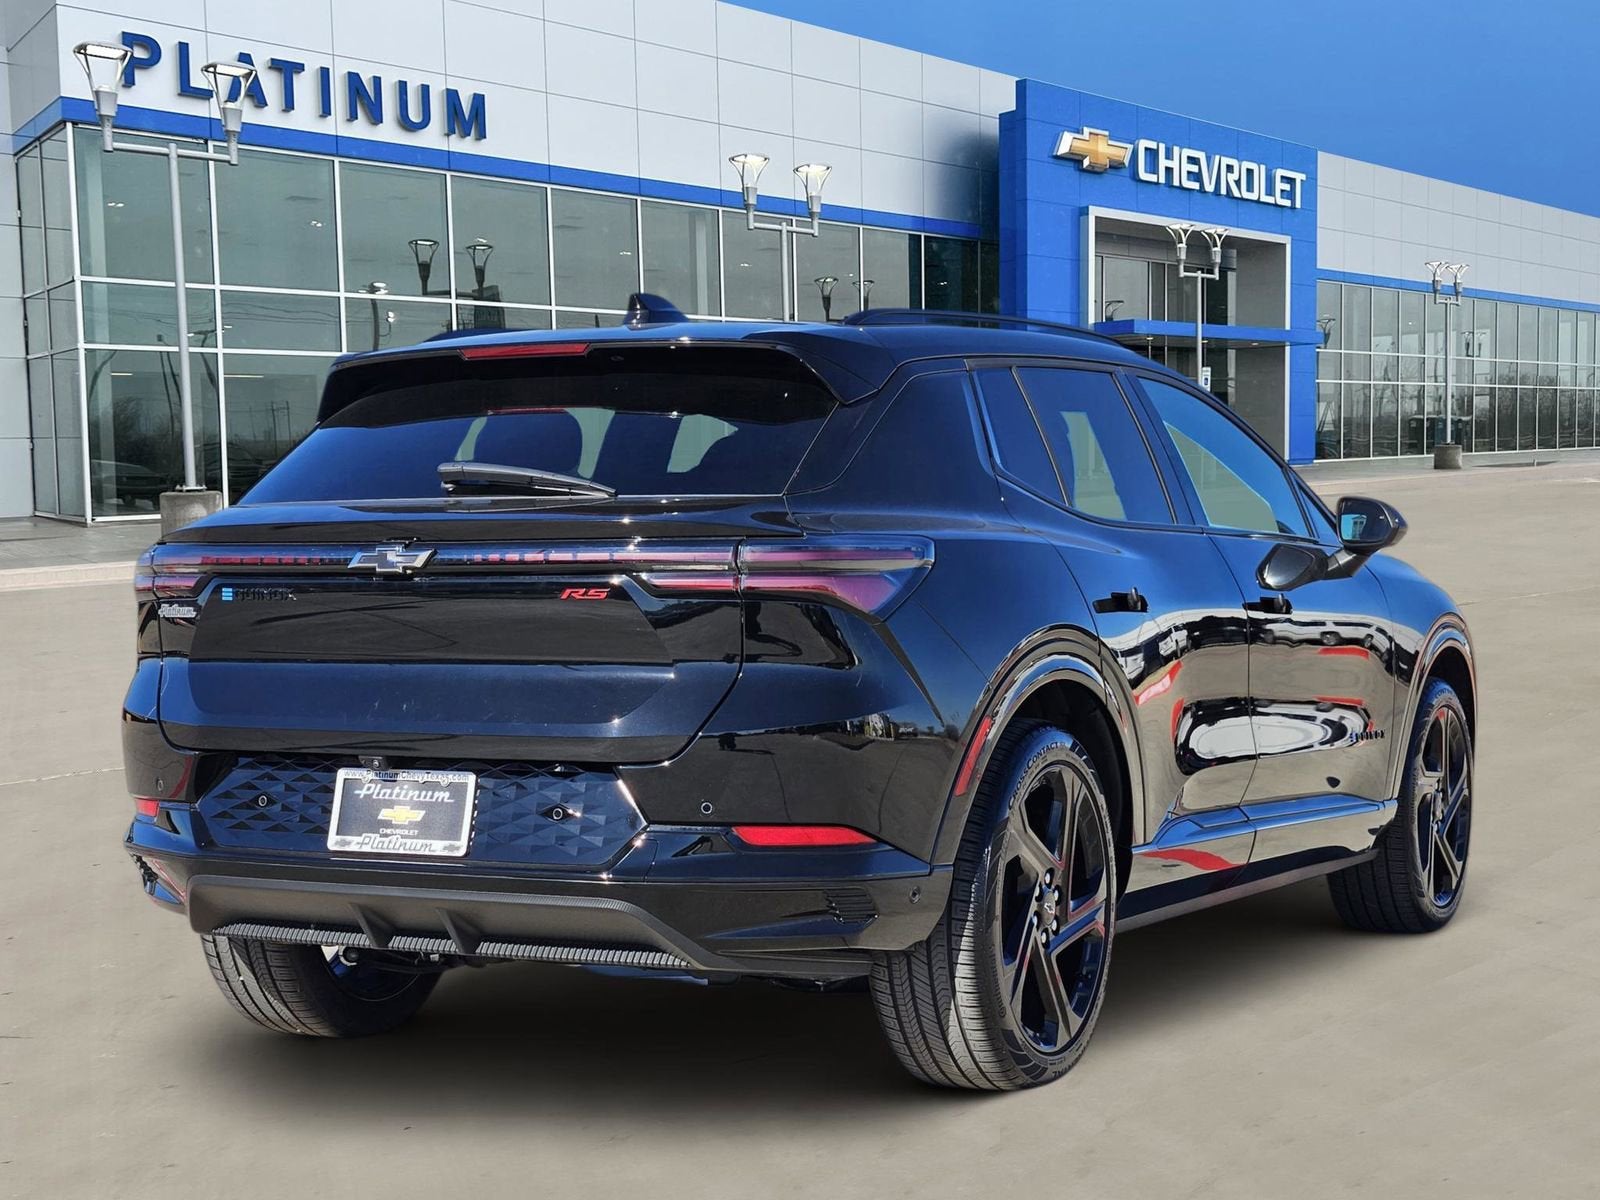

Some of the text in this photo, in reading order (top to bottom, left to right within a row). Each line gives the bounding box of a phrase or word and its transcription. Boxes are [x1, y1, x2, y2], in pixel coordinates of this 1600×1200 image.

[120, 31, 487, 140] PLATINUM
[1136, 138, 1306, 209] CHEVROLET
[560, 587, 611, 600] RS
[354, 783, 454, 802] Platinum
[379, 827, 419, 836] CHEVROLET
[355, 834, 436, 852] Platinum
